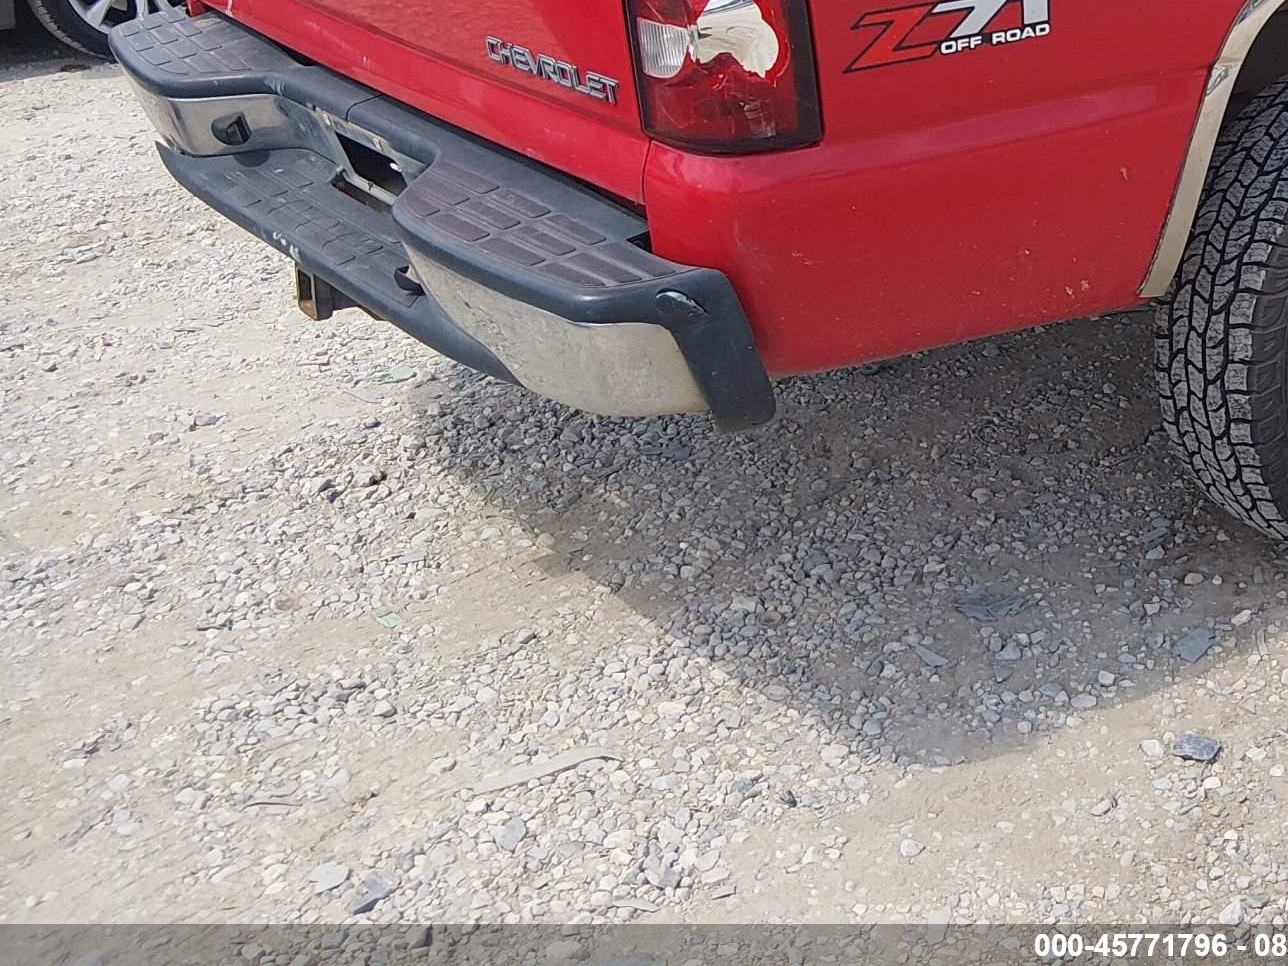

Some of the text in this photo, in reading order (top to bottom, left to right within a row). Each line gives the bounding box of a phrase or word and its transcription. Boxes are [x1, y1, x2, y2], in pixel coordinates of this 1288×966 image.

[939, 22, 1050, 55] OFF ROAD
[485, 35, 620, 106] CHEVROLET
